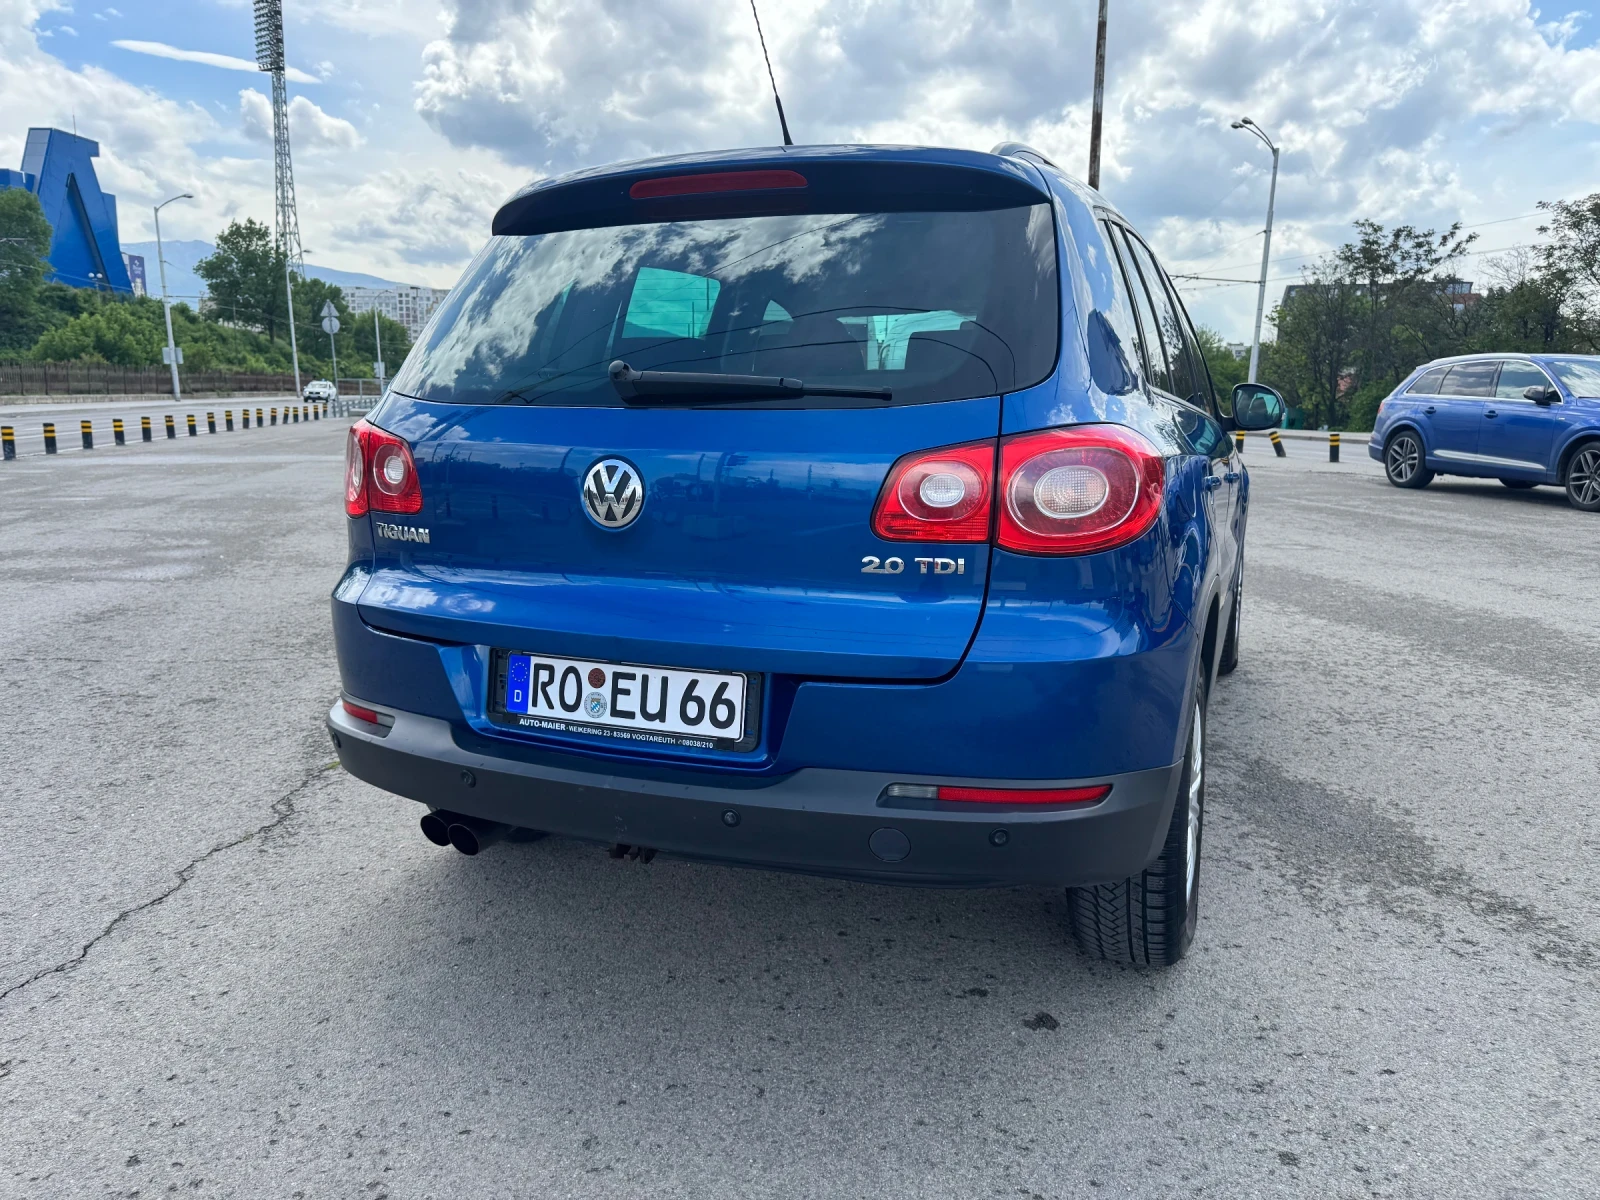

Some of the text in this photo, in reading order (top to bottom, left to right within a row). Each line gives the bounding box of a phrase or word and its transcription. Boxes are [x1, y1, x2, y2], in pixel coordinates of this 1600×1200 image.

[376, 522, 430, 543] TIGUAN
[914, 558, 964, 574] TDI
[513, 689, 522, 702] D
[531, 663, 583, 713] RO
[610, 671, 669, 723] EU
[679, 679, 736, 730] 66
[519, 718, 566, 731] AUTO-MAIER
[569, 725, 602, 735] WEIKERING
[603, 729, 611, 737] 23
[631, 733, 676, 744] VOGTAREUTH
